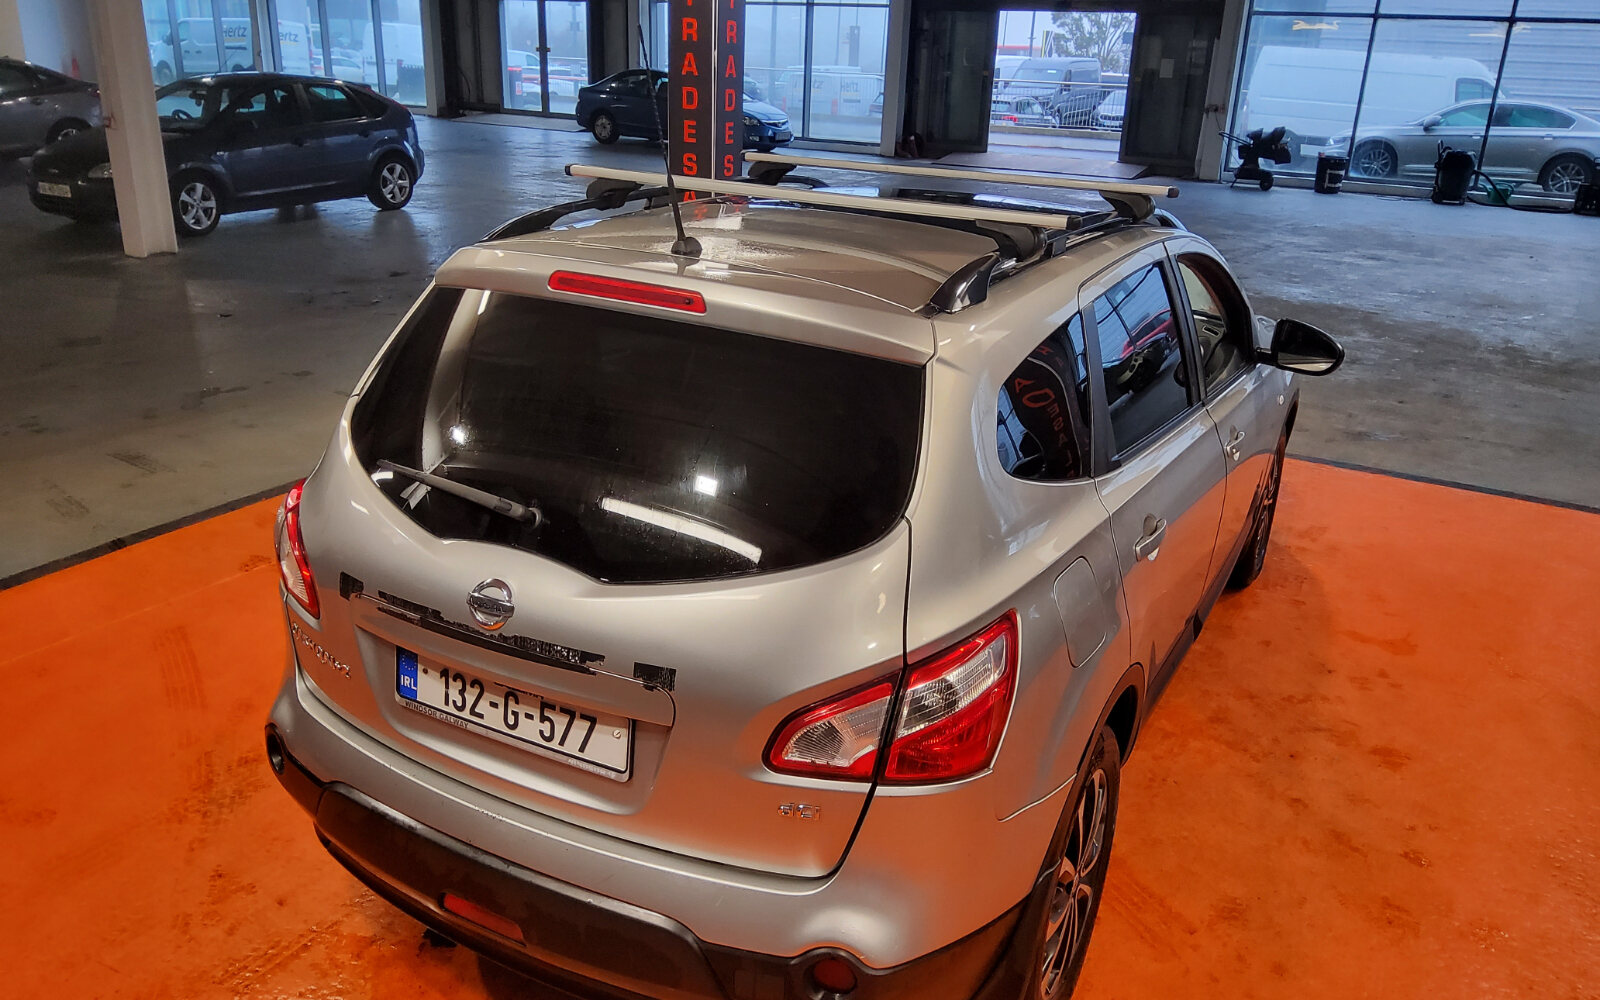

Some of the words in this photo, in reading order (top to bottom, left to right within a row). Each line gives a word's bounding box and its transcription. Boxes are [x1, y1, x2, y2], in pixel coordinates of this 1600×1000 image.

[682, 0, 698, 175] RADES
[400, 673, 417, 690] IRL
[405, 701, 437, 717] WINDSOR
[440, 713, 468, 729] GALWAY
[439, 668, 597, 753] 132-G-577
